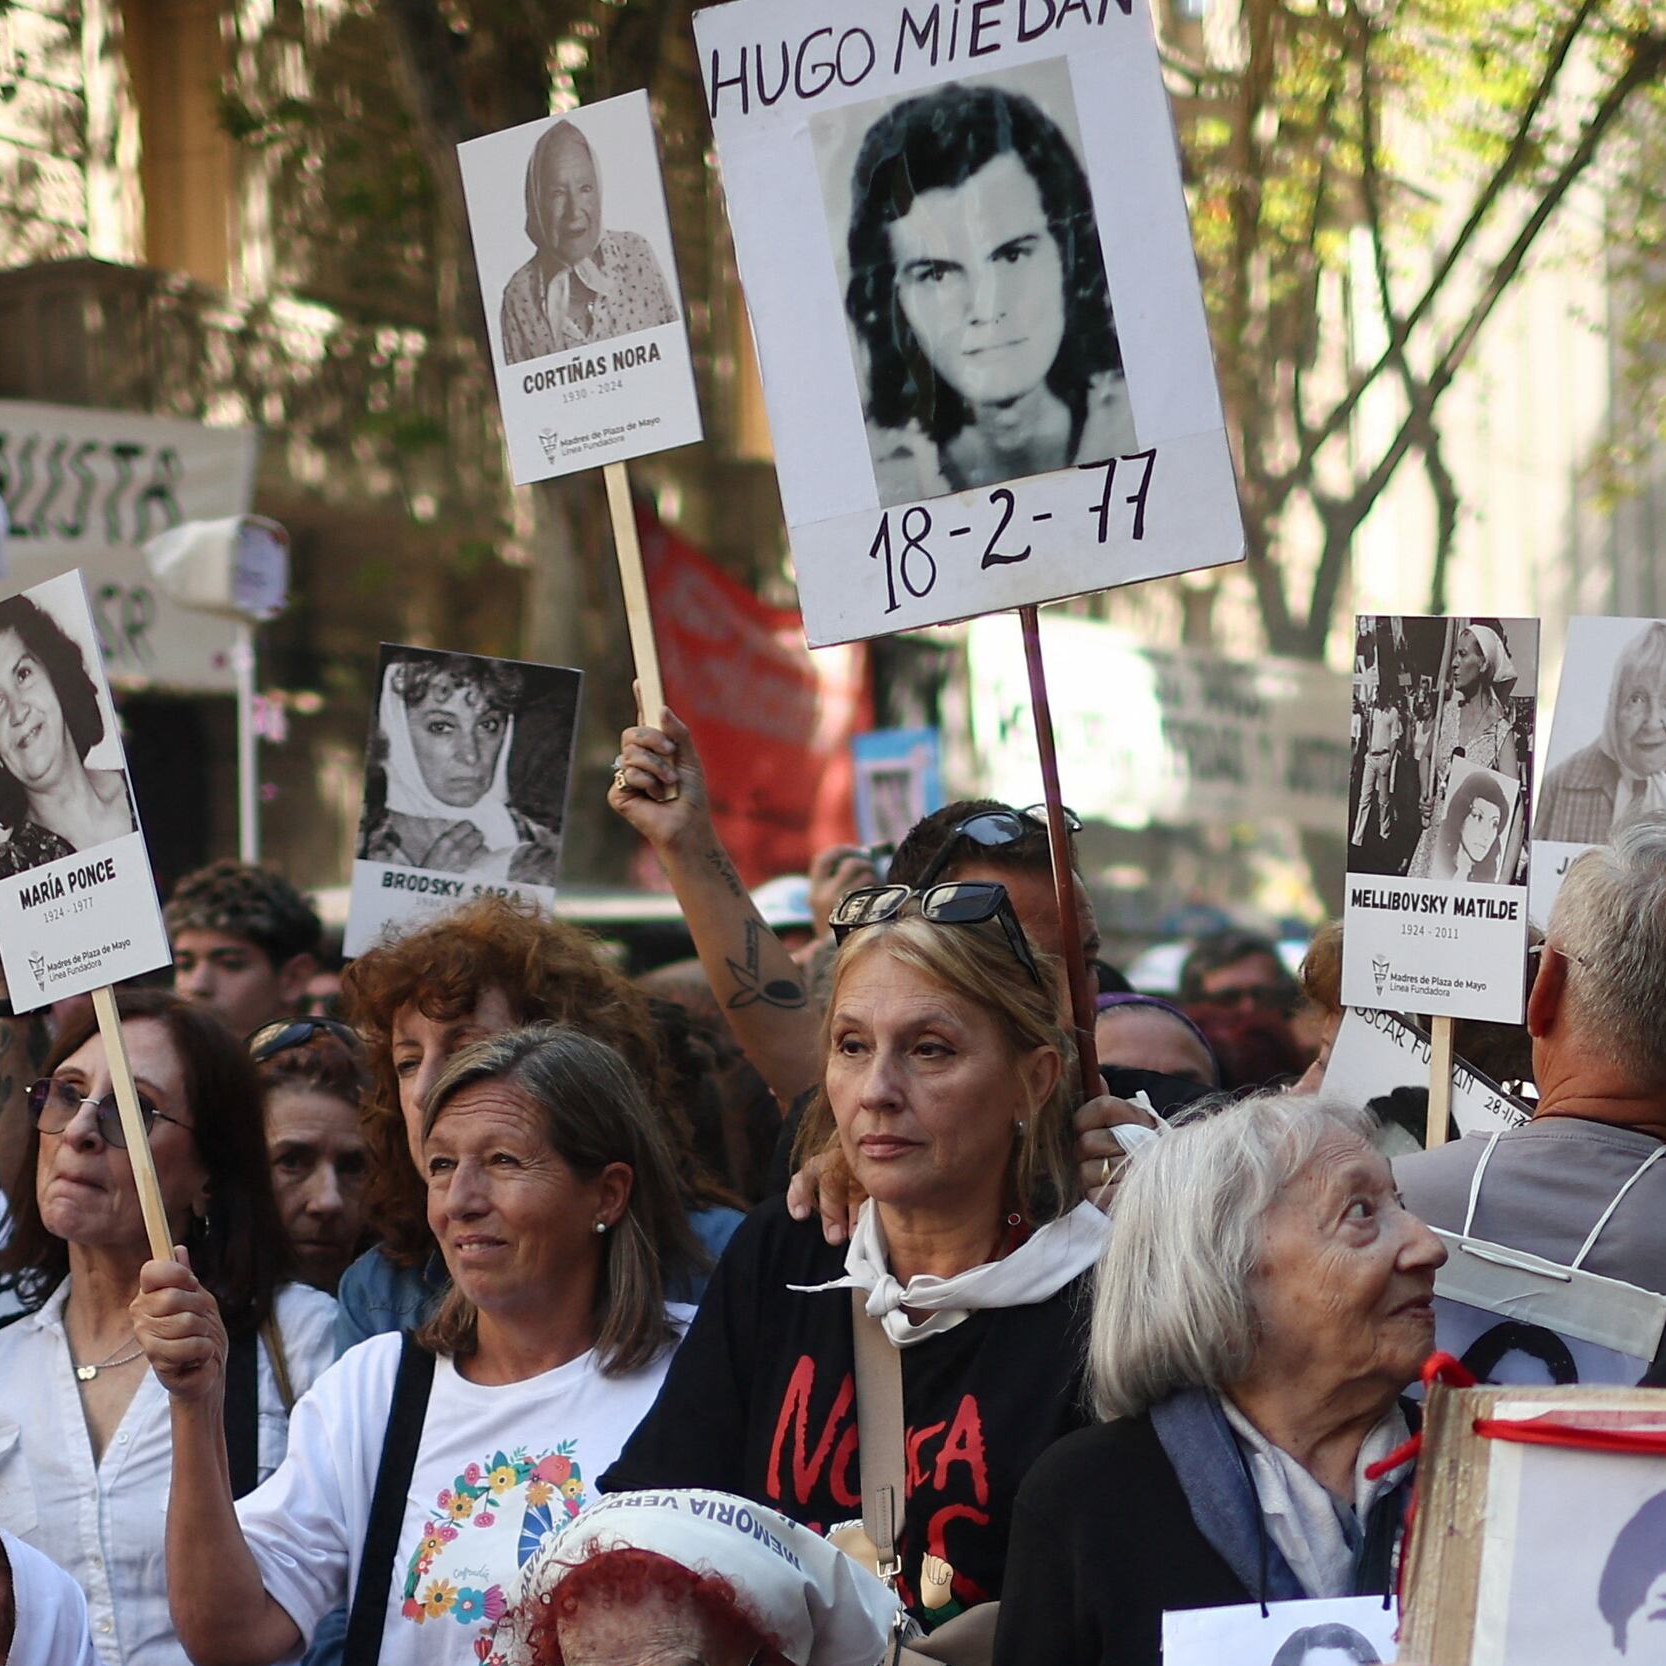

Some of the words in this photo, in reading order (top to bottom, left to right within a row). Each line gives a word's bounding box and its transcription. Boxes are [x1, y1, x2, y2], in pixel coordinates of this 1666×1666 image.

[711, 27, 876, 118] HUGO
[523, 355, 607, 394] CORTIÑAS
[612, 343, 661, 371] NORA
[597, 381, 623, 394] 2024
[19, 874, 66, 910] MARÍA
[67, 857, 116, 893] PONCE
[382, 870, 465, 899] BRODSKY
[43, 908, 64, 924] 1924
[71, 897, 94, 914] 1977
[1351, 888, 1448, 916] MELLIBOVSKY
[1453, 897, 1519, 922] MATILDE
[1401, 923, 1425, 938] 1924
[1435, 926, 1459, 940] 2011
[47, 958, 71, 972] Madres
[82, 949, 101, 960] Plaza
[111, 939, 131, 951] Mayo
[1390, 972, 1419, 985] Madres
[1421, 975, 1430, 986] de
[1431, 976, 1452, 987] Plaza
[1454, 978, 1464, 988] de
[1466, 980, 1487, 993] Mayo
[1410, 985, 1451, 997] Fundadora
[1412, 1037, 1475, 1096] FUAN
[691, 1497, 803, 1574] MEMORIA
